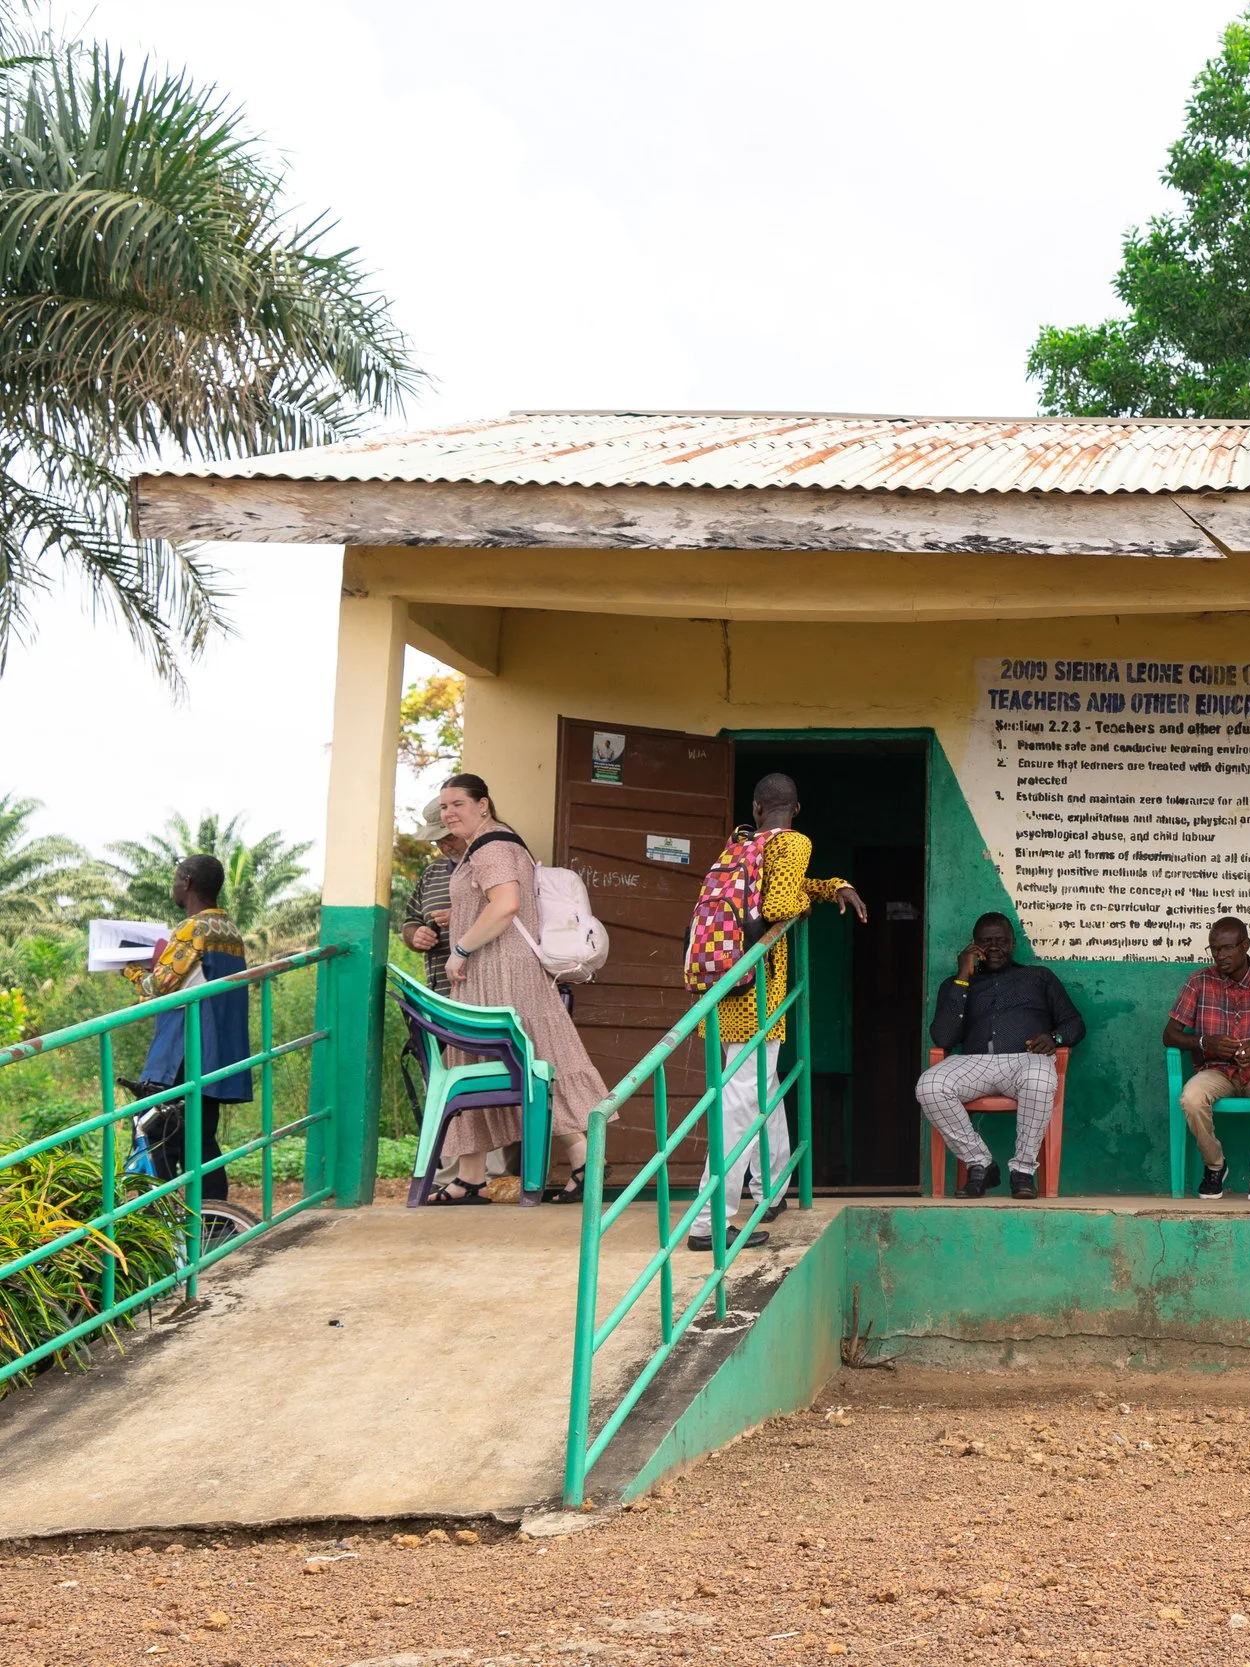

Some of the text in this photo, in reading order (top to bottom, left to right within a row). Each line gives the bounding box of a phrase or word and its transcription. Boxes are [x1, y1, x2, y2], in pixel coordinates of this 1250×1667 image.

[1000, 659, 1047, 681] 2009
[1055, 660, 1120, 682] SIERRA
[1126, 662, 1184, 684] LEONE
[1189, 663, 1236, 686] CODE
[988, 689, 1081, 712] TEACHERS
[1086, 692, 1126, 713] AND
[1131, 692, 1189, 714] OTHER
[995, 719, 1044, 733] Section
[1049, 721, 1081, 733] 2.2.3
[1095, 720, 1155, 735] Teachers
[1159, 723, 1184, 735] and
[1188, 722, 1220, 736] other
[1017, 740, 1062, 751] Promote
[1065, 741, 1087, 751] safe
[1090, 742, 1109, 752] and
[1113, 743, 1167, 754] conducive
[1170, 744, 1213, 756] learning
[1018, 758, 1054, 769] Ensure
[1057, 759, 1077, 771] that
[1080, 760, 1124, 770] learners
[1128, 762, 1144, 771] are
[1148, 761, 1186, 771] treated
[1189, 761, 1211, 772] with
[1215, 762, 1250, 774] dignity
[1017, 775, 1068, 787] protected
[1016, 791, 1064, 802] Establish
[1067, 793, 1086, 804] and
[1089, 794, 1136, 804] maintain
[1139, 796, 1163, 804] zero
[1218, 796, 1232, 806] for
[1236, 796, 1249, 806] all
[1133, 814, 1152, 824] and
[1193, 816, 1237, 828] physical
[1016, 829, 1215, 843] psychological abuse, and child labour
[1068, 849, 1082, 860] all
[1084, 849, 1115, 860] forms
[1118, 850, 1129, 861] of
[1133, 851, 1207, 863] discrimination
[1211, 854, 1221, 863] at
[1225, 853, 1237, 864] all
[1015, 865, 1053, 878] Employ
[1057, 866, 1099, 879] positive
[1102, 867, 1147, 878] methods
[1152, 867, 1162, 878] of
[1164, 868, 1218, 880] corrective
[1016, 882, 1057, 895] Actively
[1061, 884, 1105, 897] promote
[1109, 885, 1126, 895] the
[1129, 885, 1172, 898] concept
[1175, 887, 1185, 897] of
[1212, 888, 1235, 898] best
[1076, 901, 1086, 911] in
[1090, 902, 1161, 914] co-curricular
[1166, 903, 1215, 916] activities
[1217, 902, 1232, 914] for
[1189, 922, 1202, 930] as
